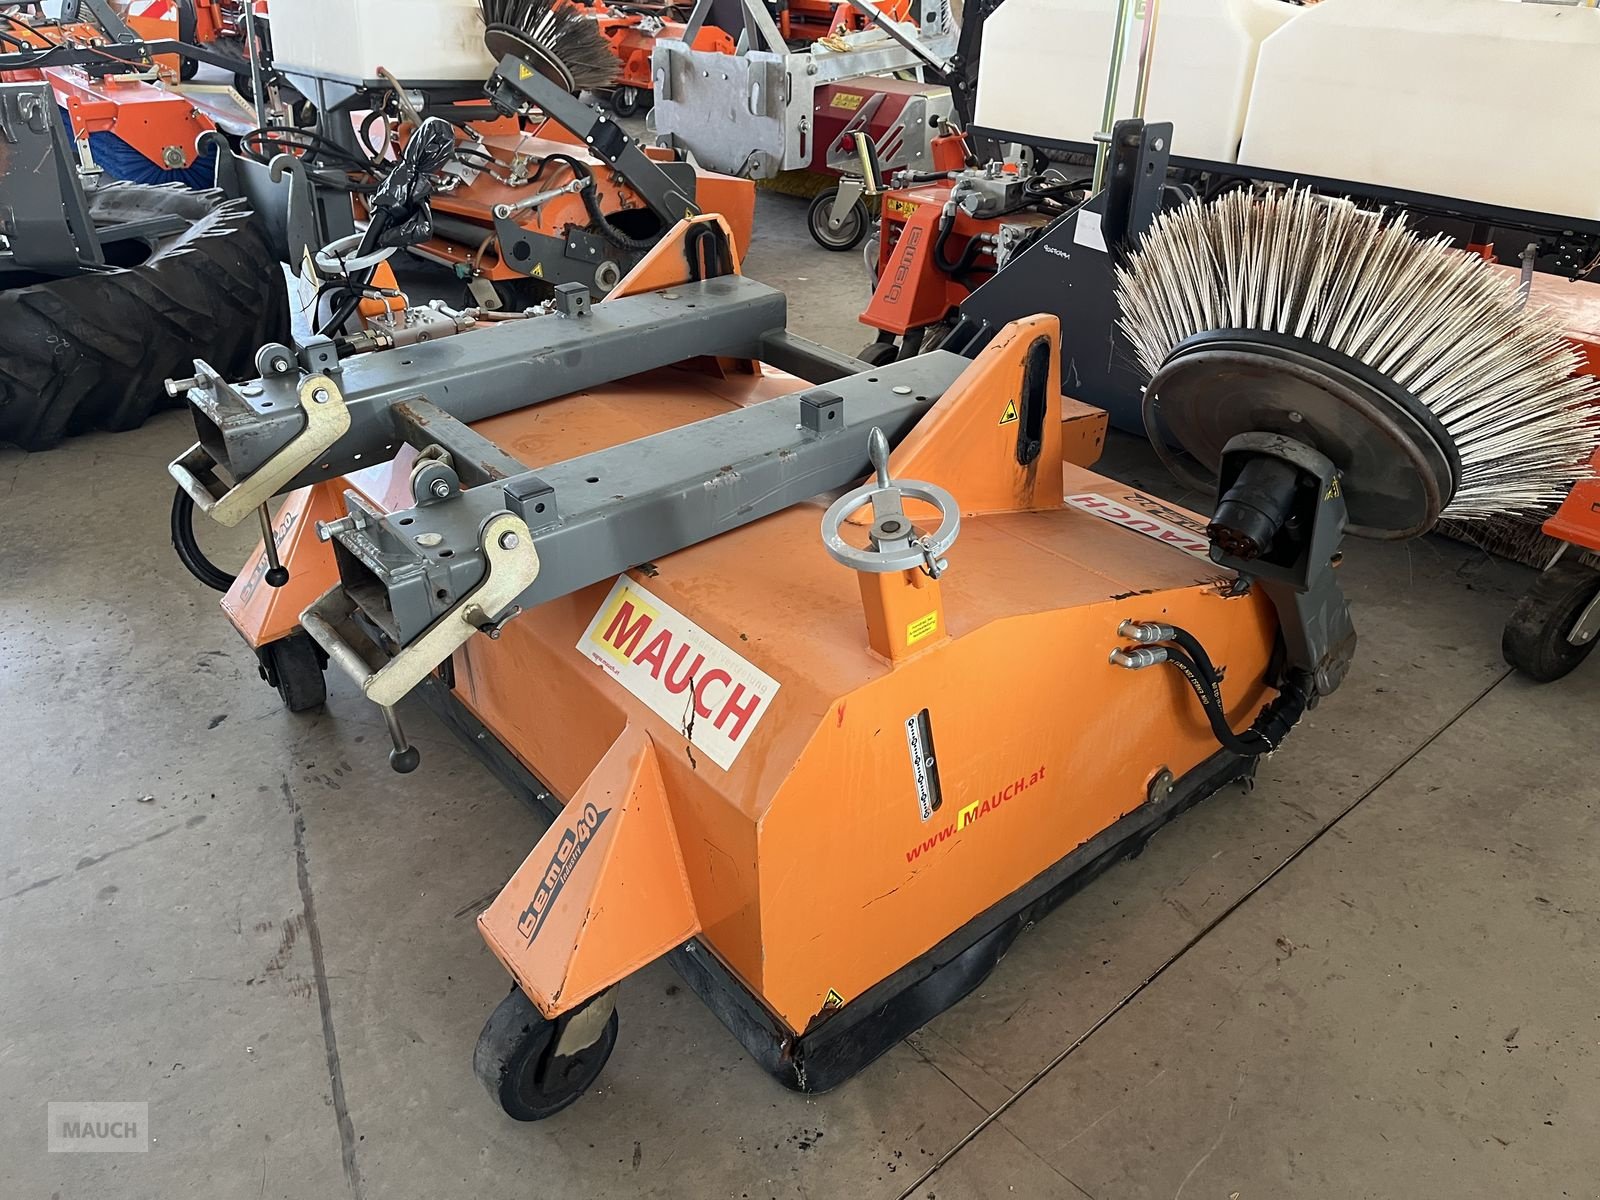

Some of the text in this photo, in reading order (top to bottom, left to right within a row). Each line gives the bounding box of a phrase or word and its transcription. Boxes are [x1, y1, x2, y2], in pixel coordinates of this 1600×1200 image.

[883, 227, 922, 304] bema
[602, 600, 761, 742] MAUCH
[906, 765, 1046, 863] www.MAUCH.at
[518, 803, 598, 939] bema 40
[559, 844, 582, 885] Industry
